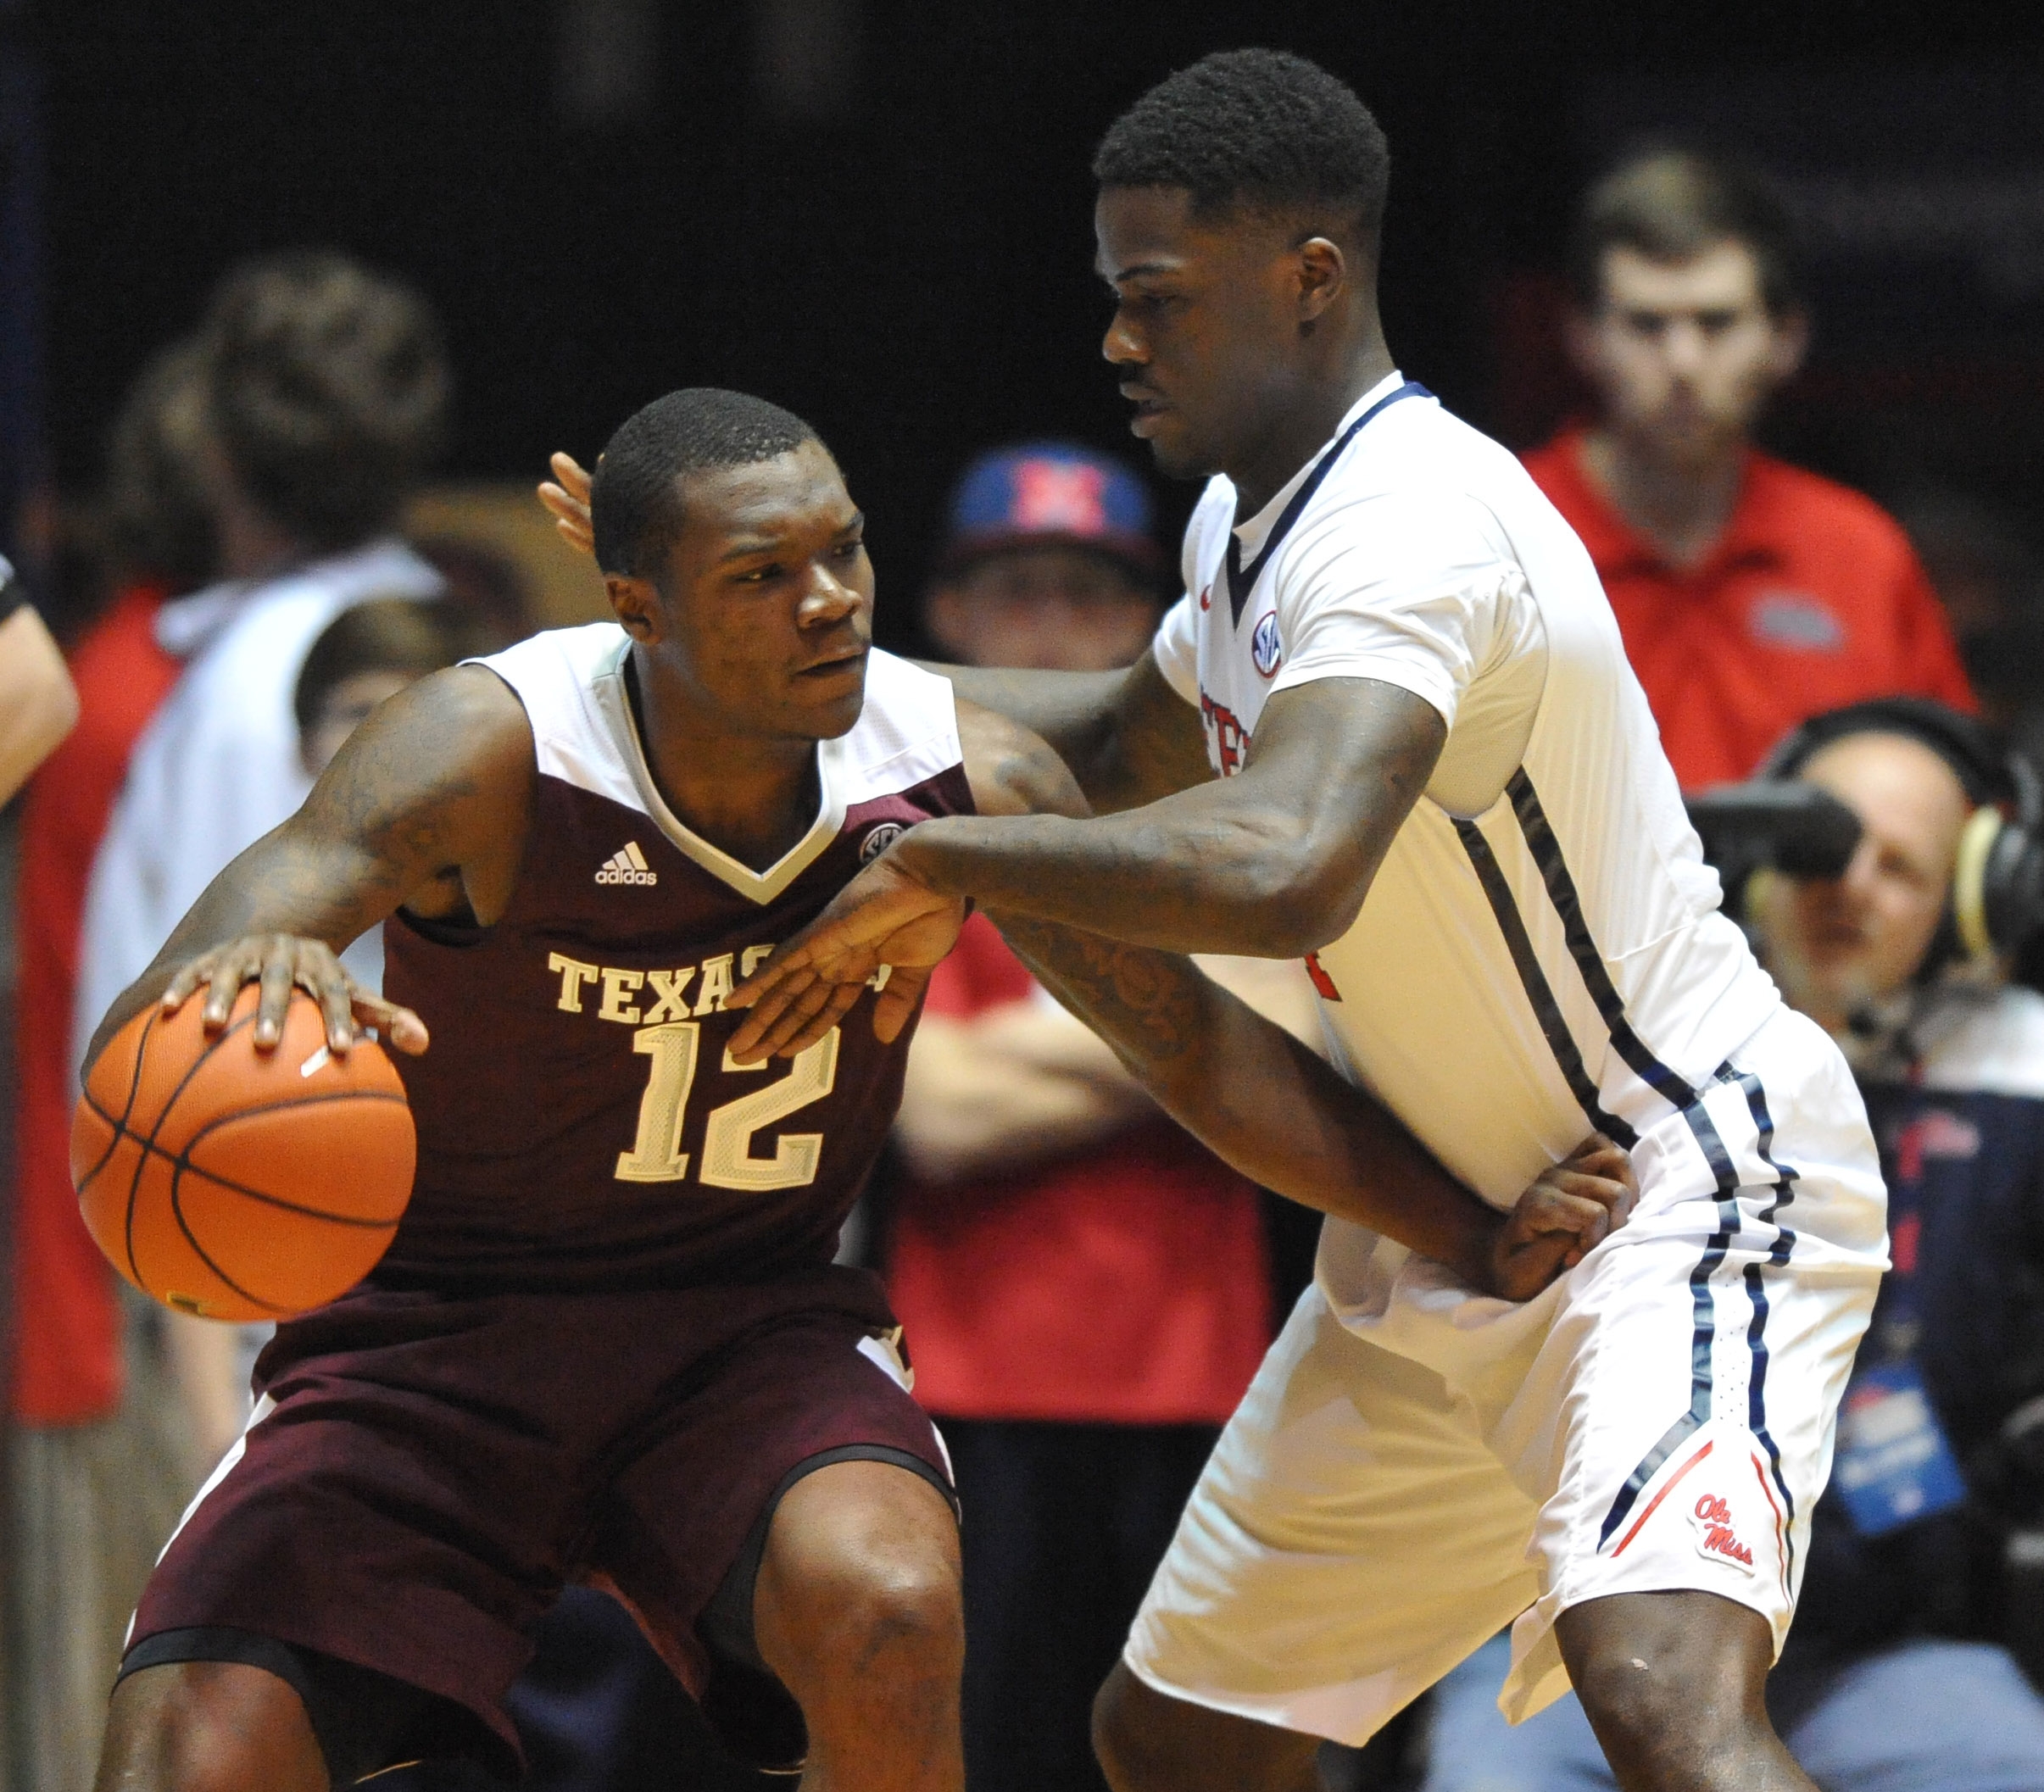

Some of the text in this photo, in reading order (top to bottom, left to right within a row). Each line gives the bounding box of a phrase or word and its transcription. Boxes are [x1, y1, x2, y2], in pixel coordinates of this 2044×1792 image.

[595, 866, 658, 886] adidas
[615, 1021, 841, 1191] 12
[1695, 1494, 1730, 1524] Ole
[1704, 1523, 1752, 1566] Miss
